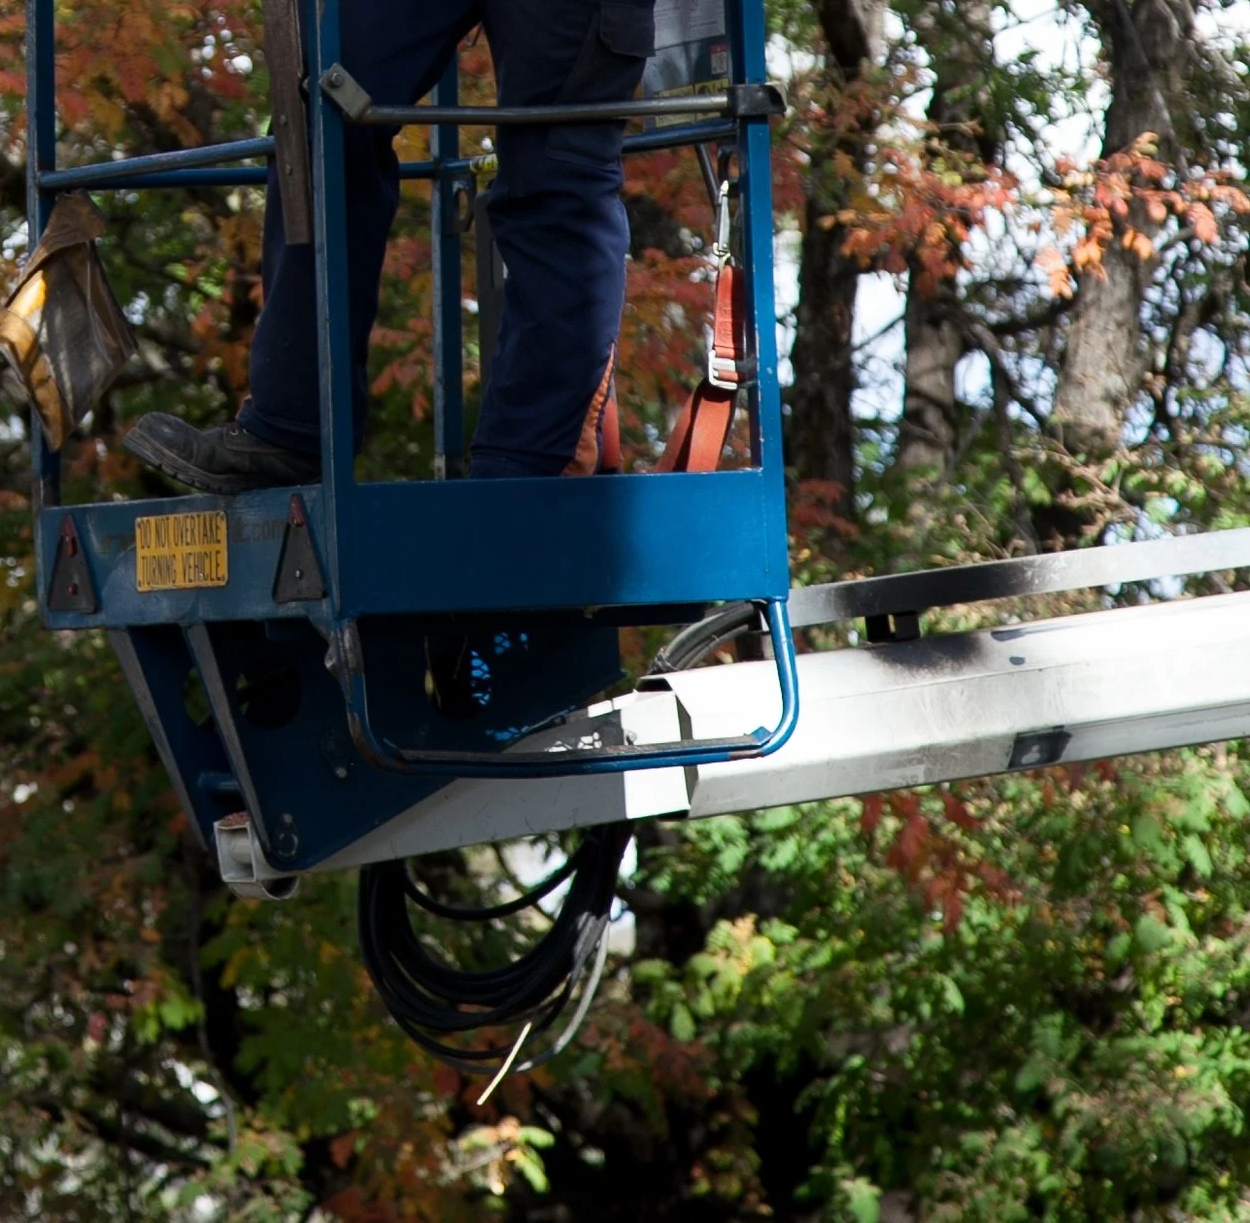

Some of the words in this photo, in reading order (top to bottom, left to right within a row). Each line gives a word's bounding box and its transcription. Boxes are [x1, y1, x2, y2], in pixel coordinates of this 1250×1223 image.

[140, 518, 151, 549] DO
[155, 516, 171, 548] NOT
[174, 511, 221, 546] OVERTAKE
[141, 554, 176, 586] TURNING
[182, 550, 221, 583] VEHICLE
